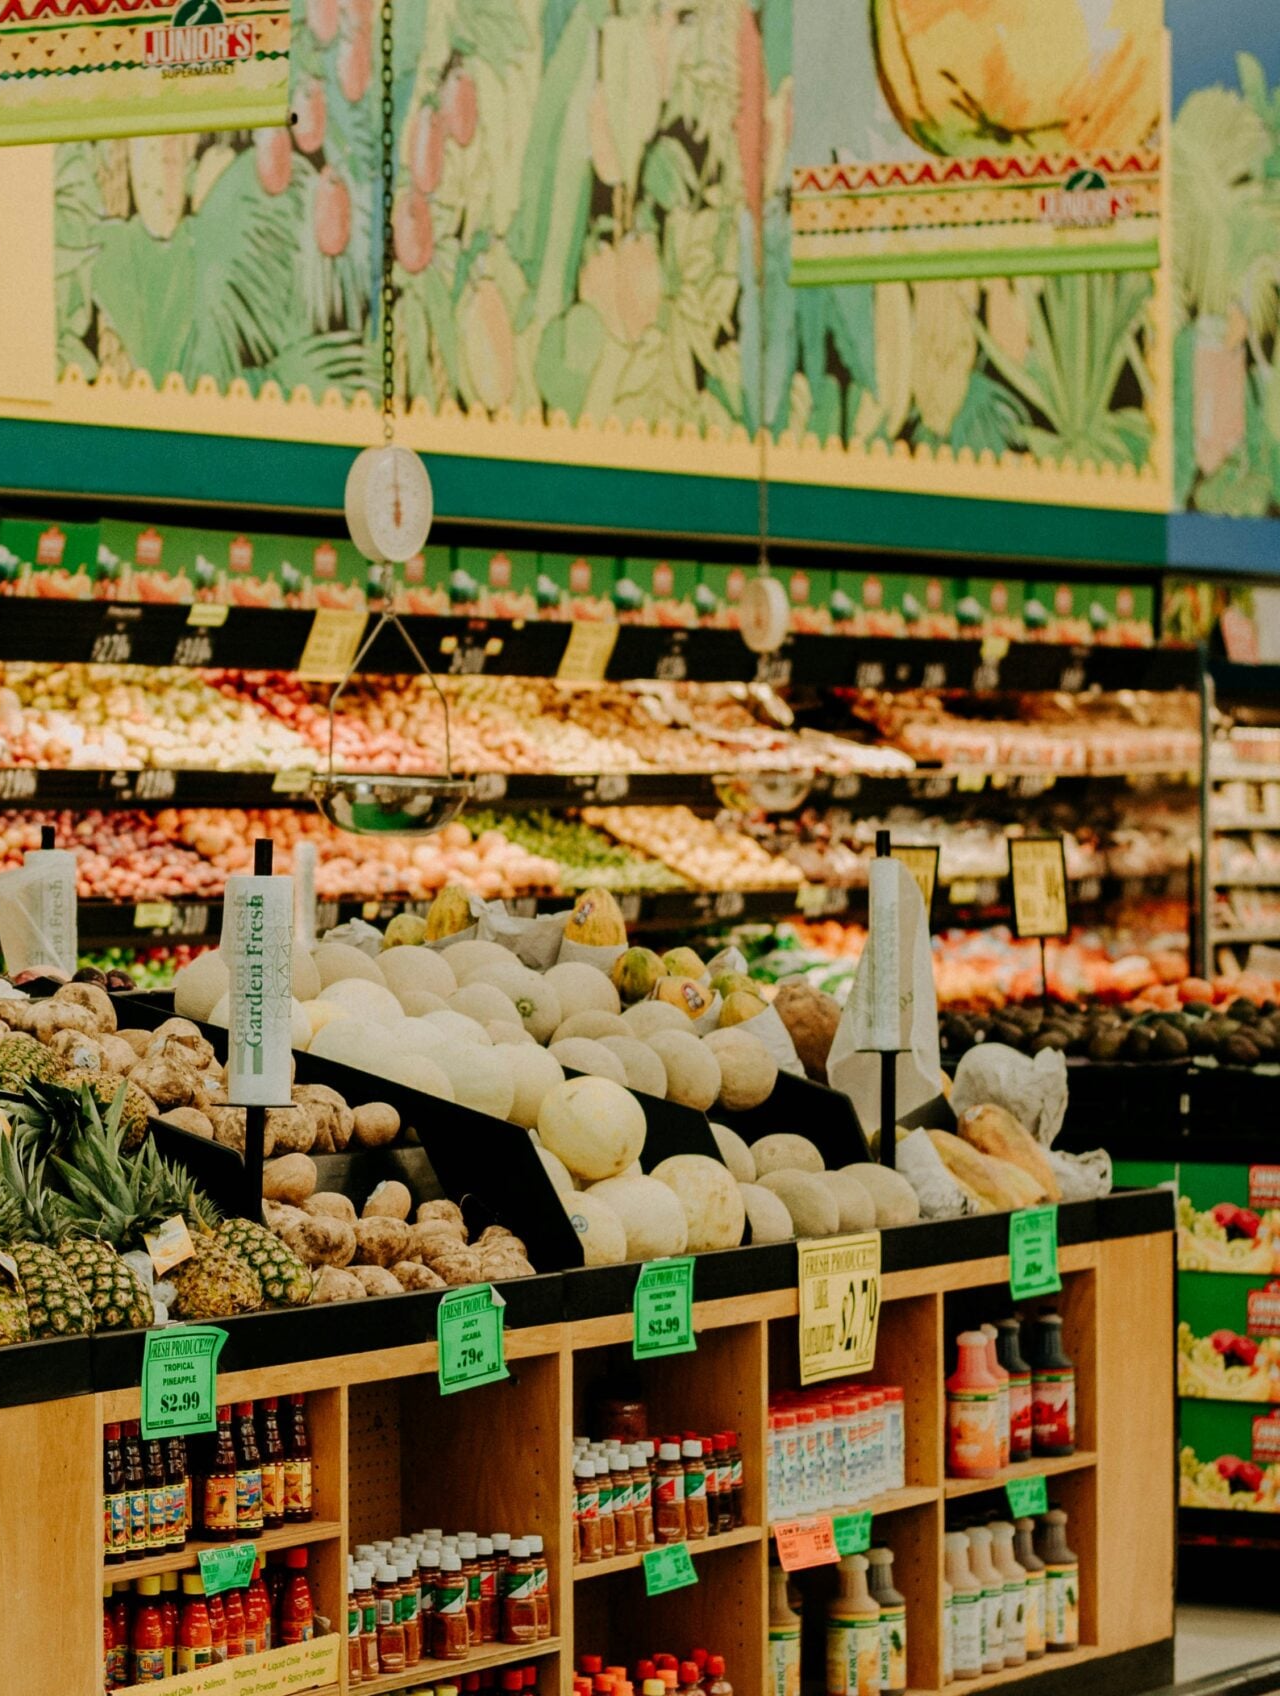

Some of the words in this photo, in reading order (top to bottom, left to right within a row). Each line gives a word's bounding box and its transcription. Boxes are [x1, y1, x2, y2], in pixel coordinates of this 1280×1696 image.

[147, 26, 251, 63] JUNIOR'S
[162, 64, 235, 79] SUPERMARKET
[245, 893, 263, 957] Fresh
[245, 964, 263, 1048] Garden
[164, 1362, 194, 1372] TROPICAL
[163, 1375, 196, 1386] PINEAPPLE
[161, 1391, 200, 1414] $2.99
